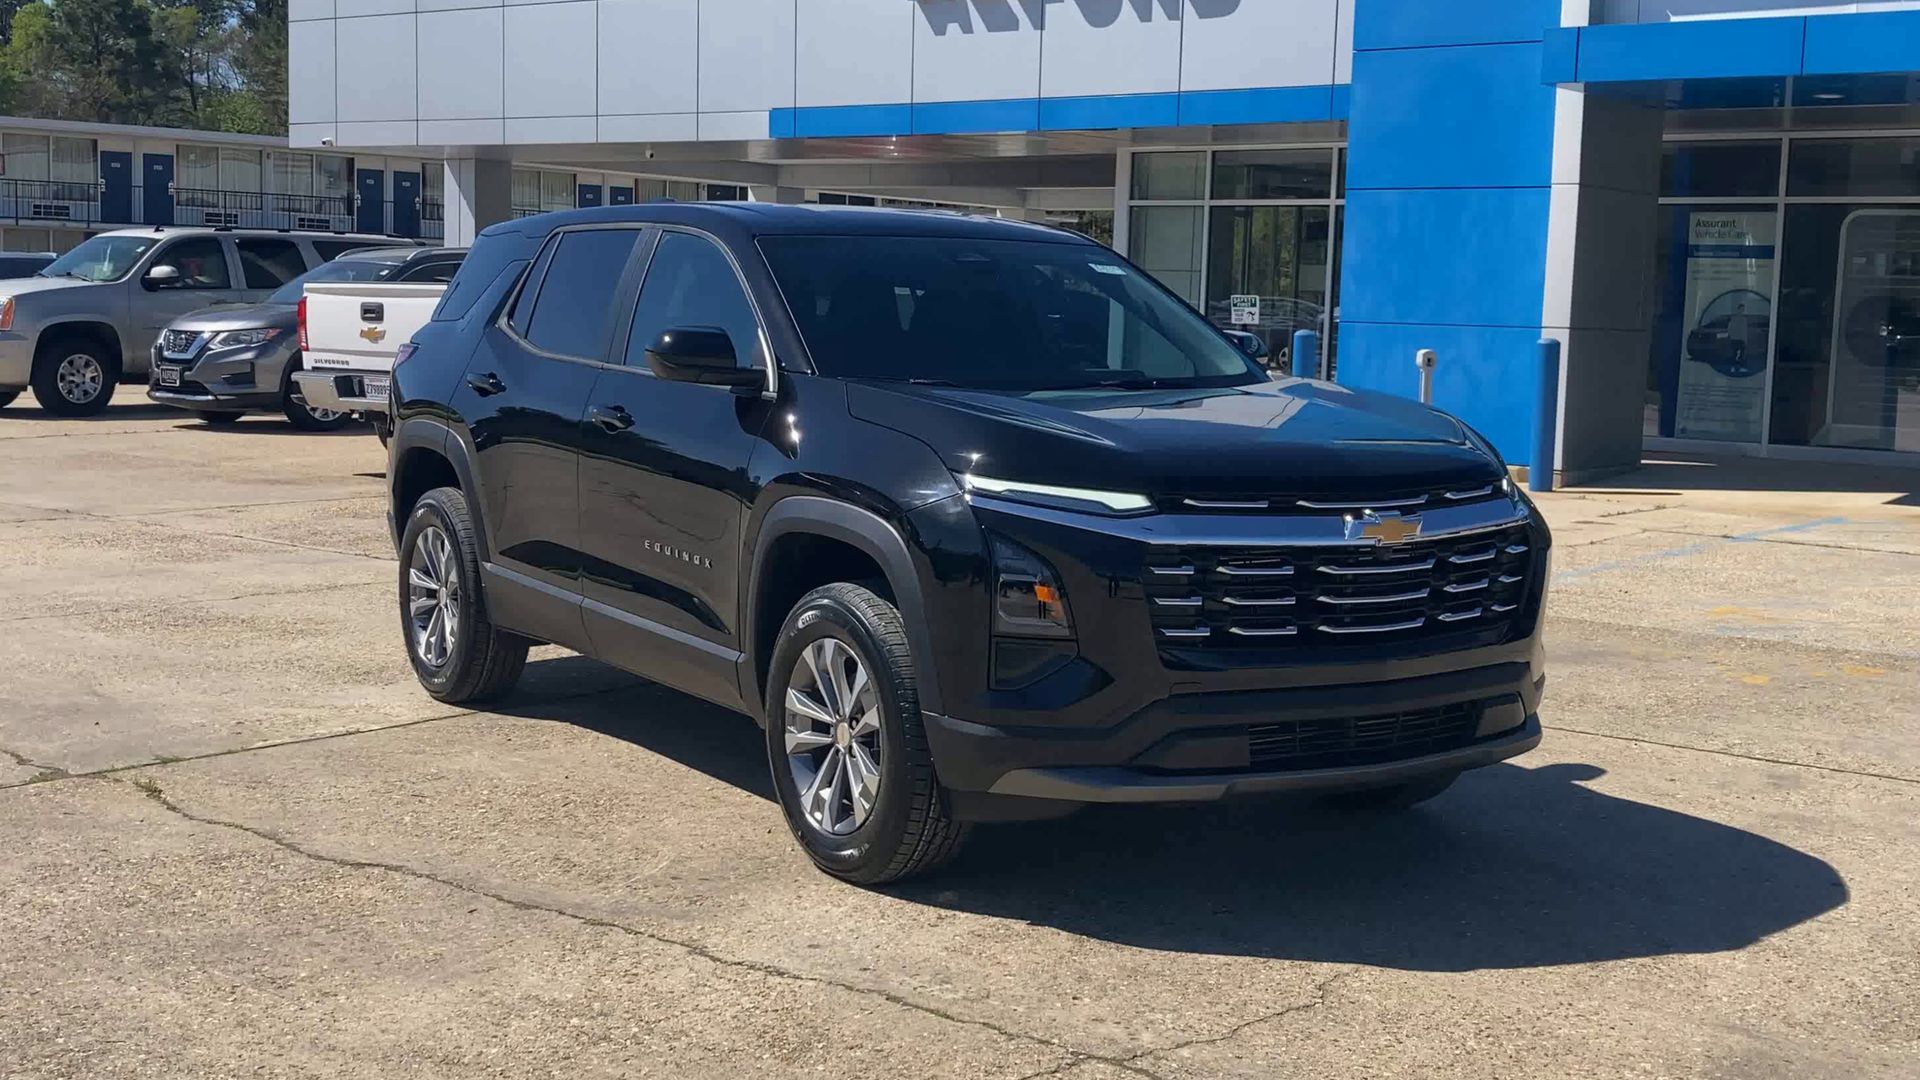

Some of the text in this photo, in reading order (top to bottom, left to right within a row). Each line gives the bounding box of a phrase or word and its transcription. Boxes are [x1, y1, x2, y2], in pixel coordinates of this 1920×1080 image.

[1695, 218, 1737, 228] Assurant
[313, 358, 350, 366] SILVERADO
[644, 539, 712, 569] EQUINOX
